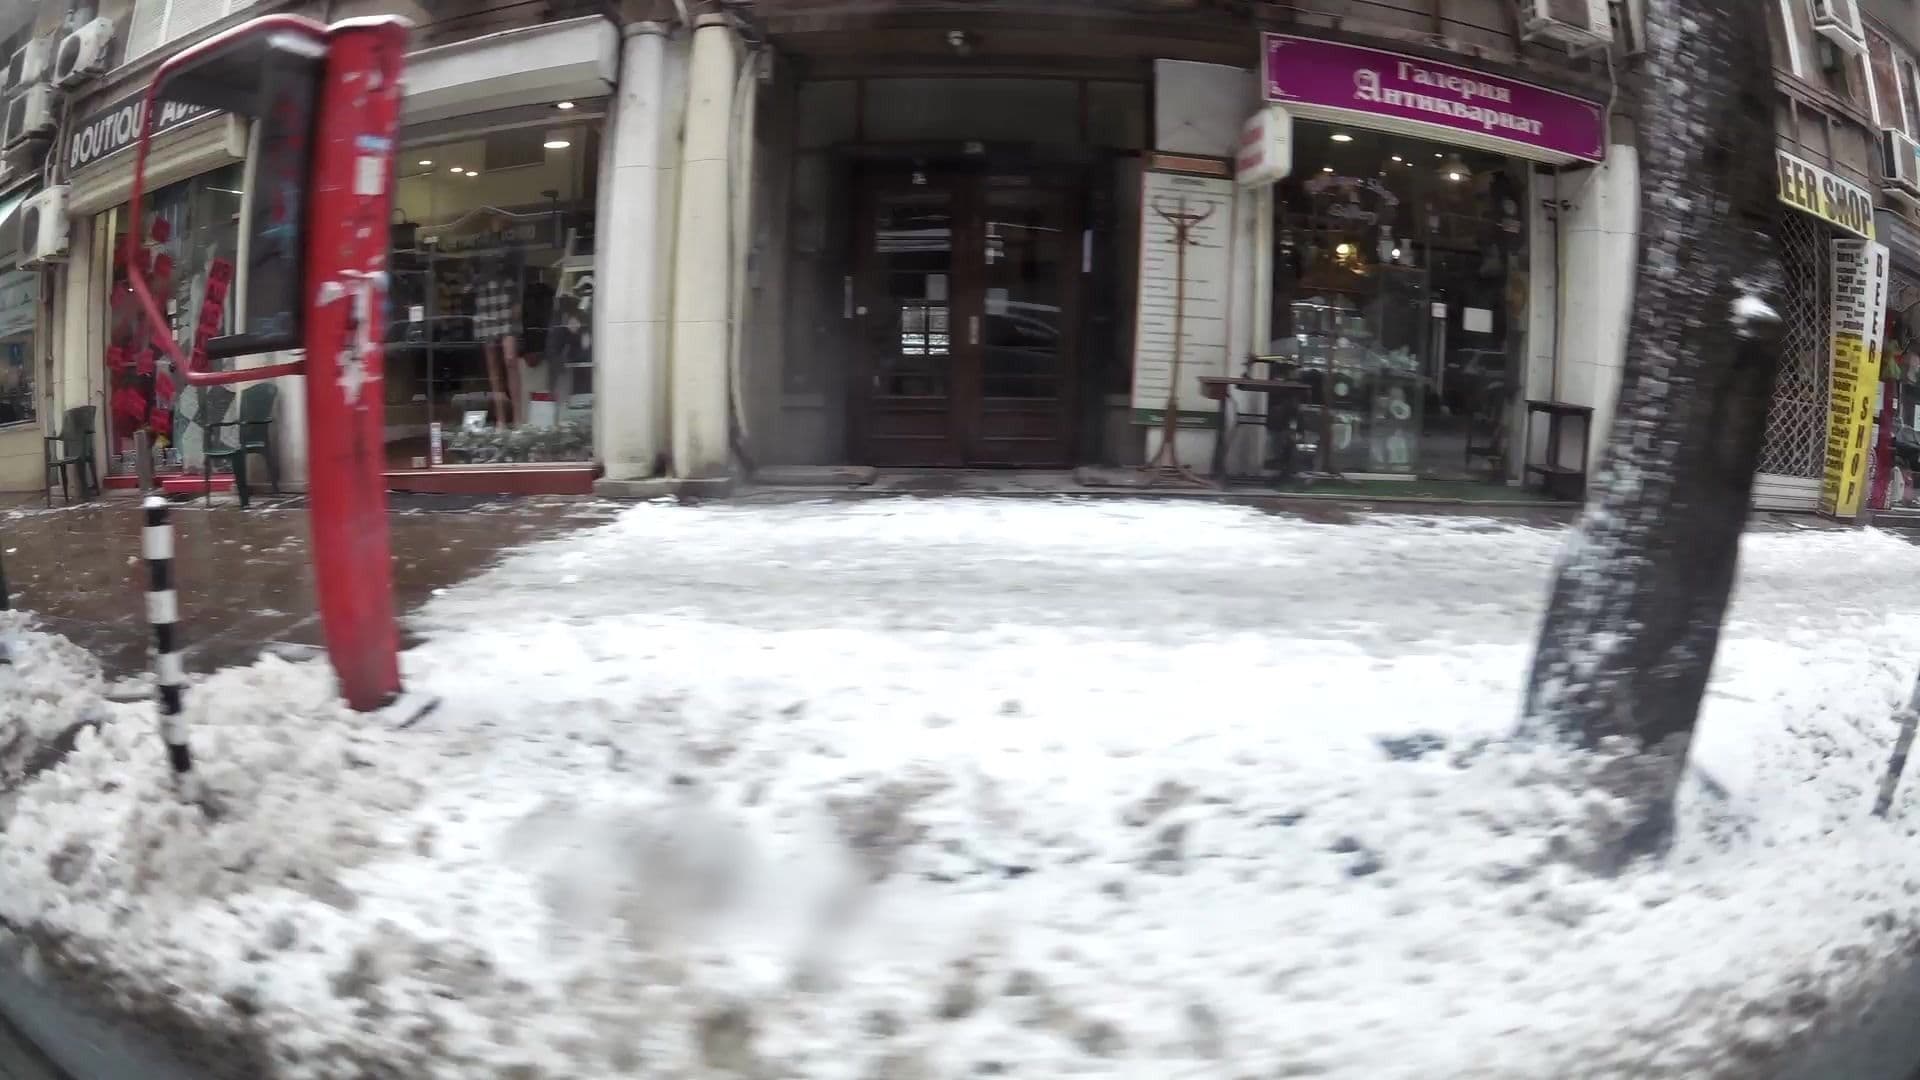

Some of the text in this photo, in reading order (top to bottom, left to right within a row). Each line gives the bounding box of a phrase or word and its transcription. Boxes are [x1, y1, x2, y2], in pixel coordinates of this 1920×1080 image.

[1353, 68, 1544, 135] Антиквариат
[1397, 61, 1512, 103] Галерия
[70, 99, 154, 167] BOUTIQU
[1777, 155, 1872, 236] EER SHOP
[1845, 252, 1883, 505] BEER SHOP
